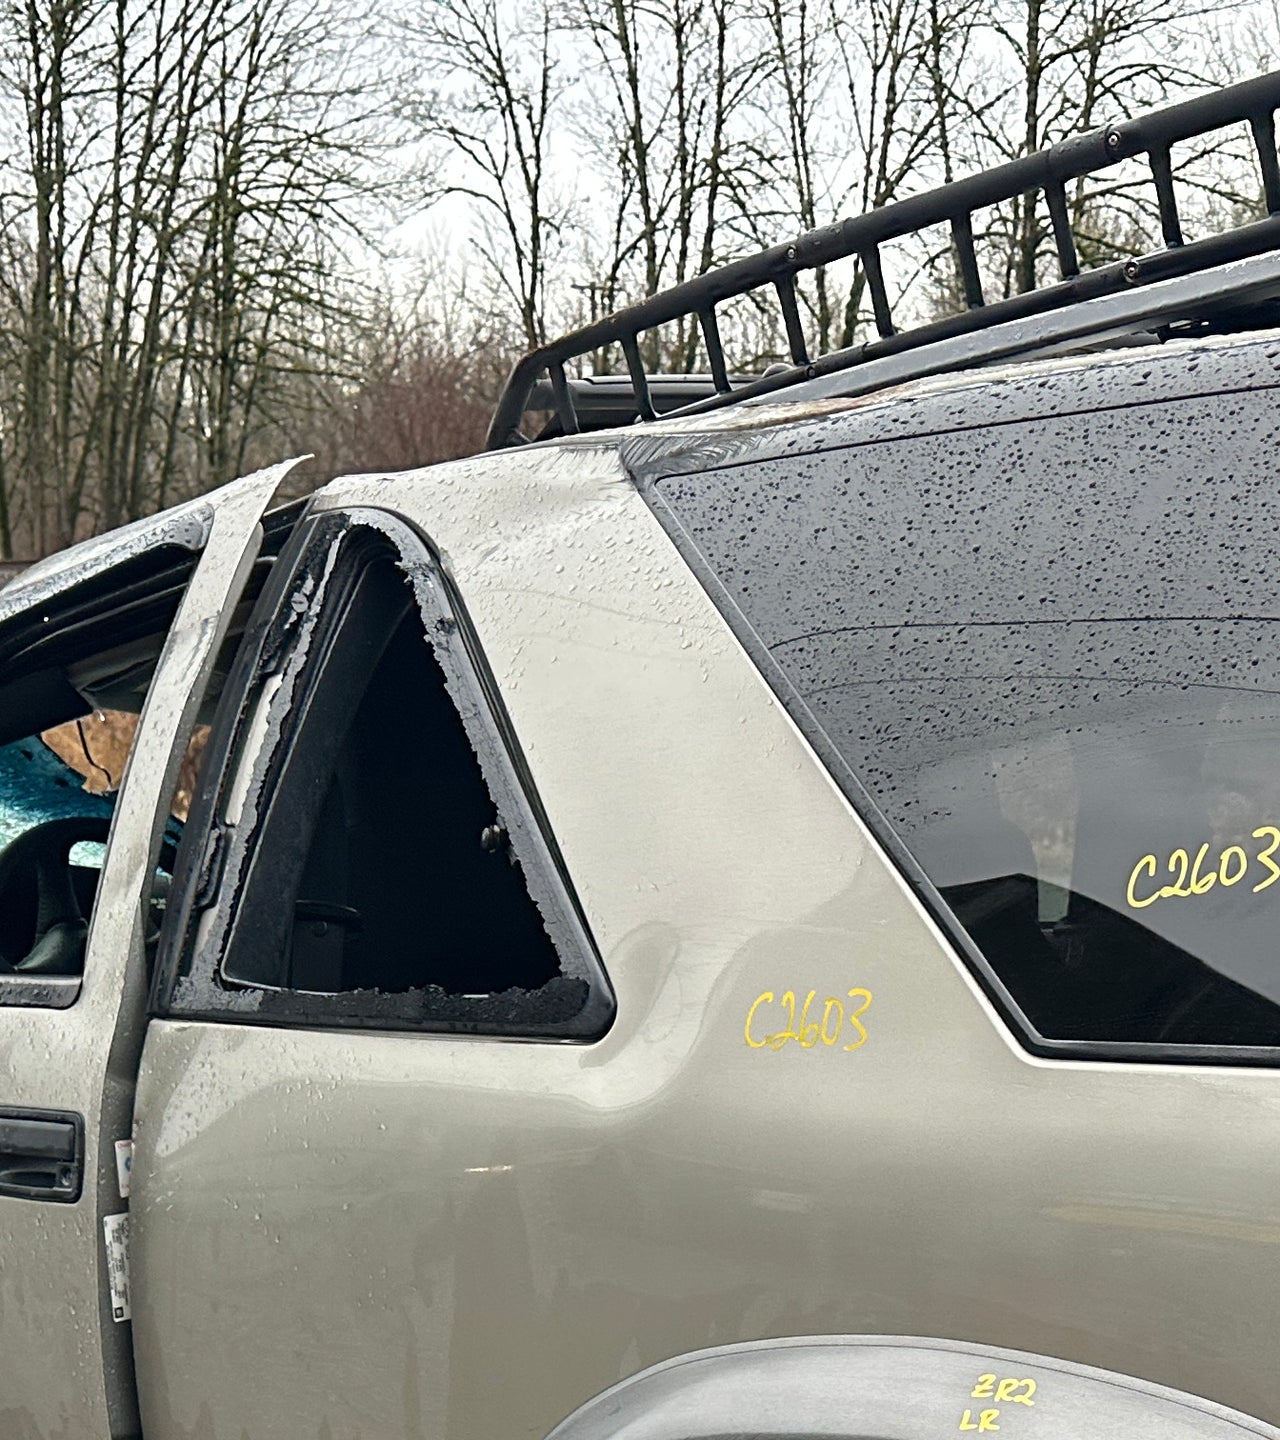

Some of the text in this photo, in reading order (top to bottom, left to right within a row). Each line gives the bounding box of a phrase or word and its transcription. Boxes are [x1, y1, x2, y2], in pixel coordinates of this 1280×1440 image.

[743, 986, 873, 1052] C2603
[970, 1372, 1038, 1407] ZR2
[958, 1407, 1001, 1433] LR
